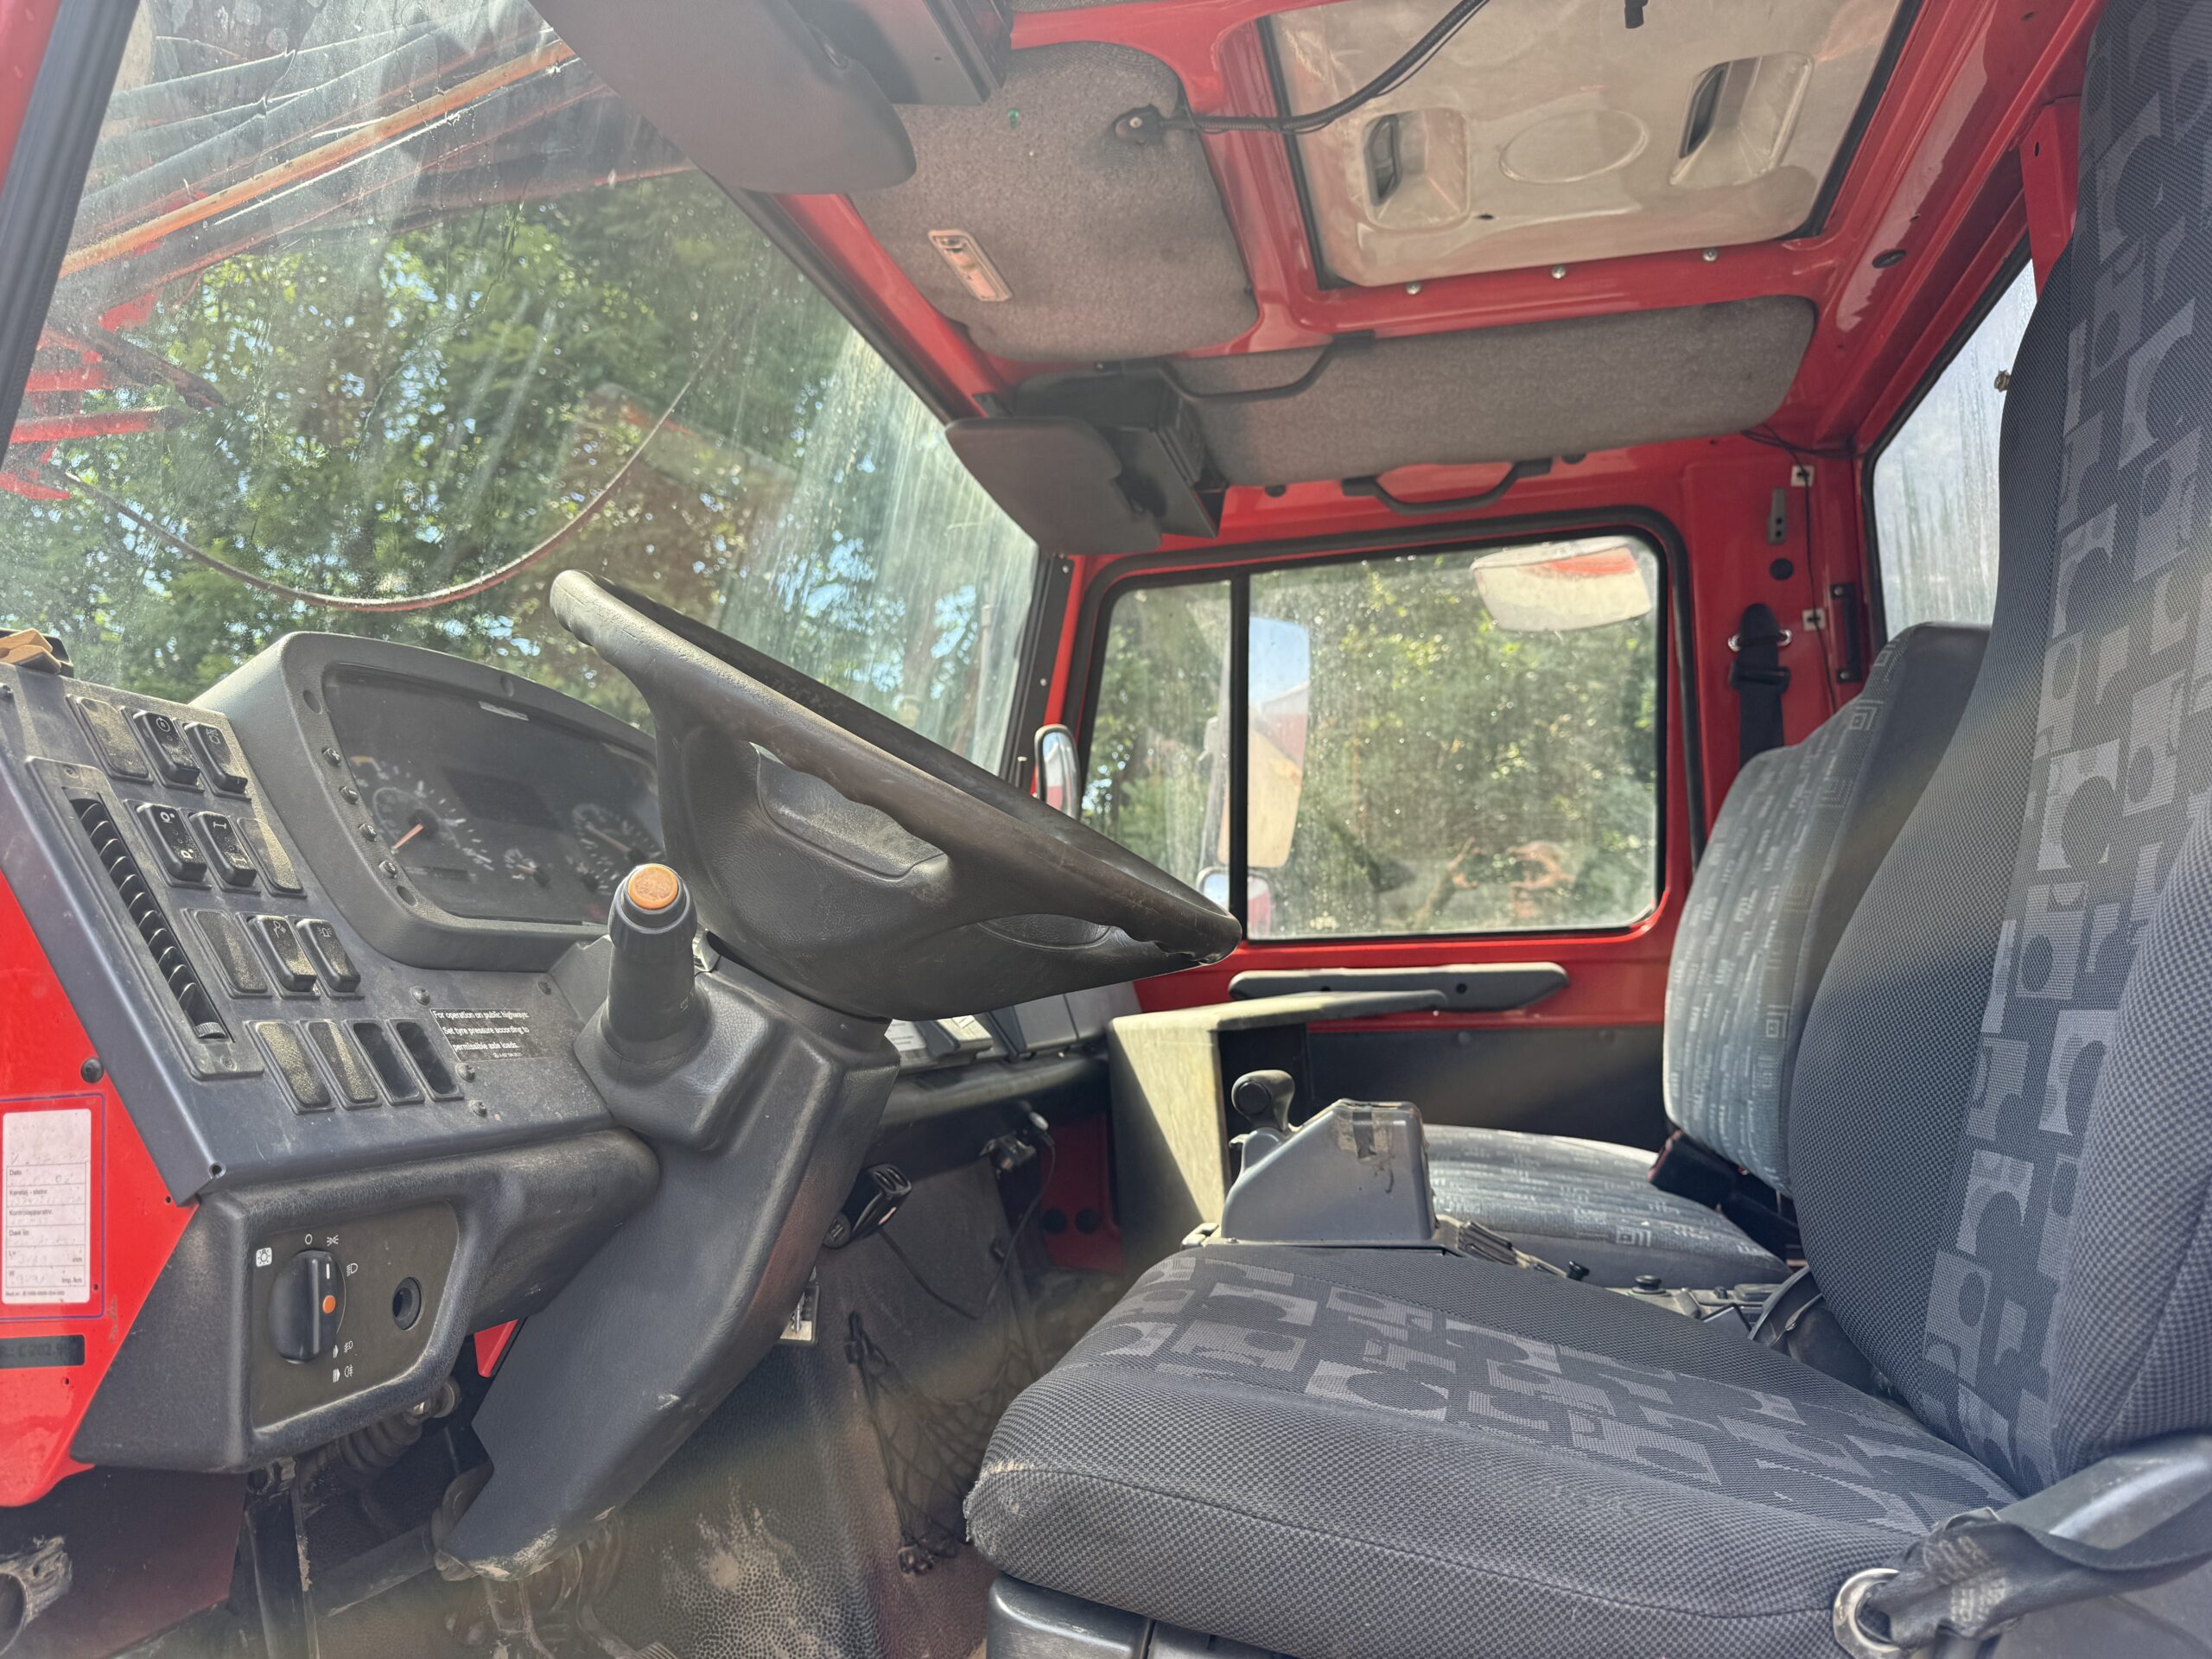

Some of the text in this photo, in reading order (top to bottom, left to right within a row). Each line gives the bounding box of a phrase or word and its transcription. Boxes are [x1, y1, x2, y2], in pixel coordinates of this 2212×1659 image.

[433, 1010, 445, 1019] For
[445, 1011, 474, 1020] operation
[484, 1010, 501, 1020] public
[442, 1027, 455, 1035] Set
[454, 1027, 468, 1036] tyre
[467, 1027, 495, 1036] pressure
[494, 1026, 524, 1034] according
[452, 1042, 488, 1052] permissible
[487, 1041, 501, 1050] axle
